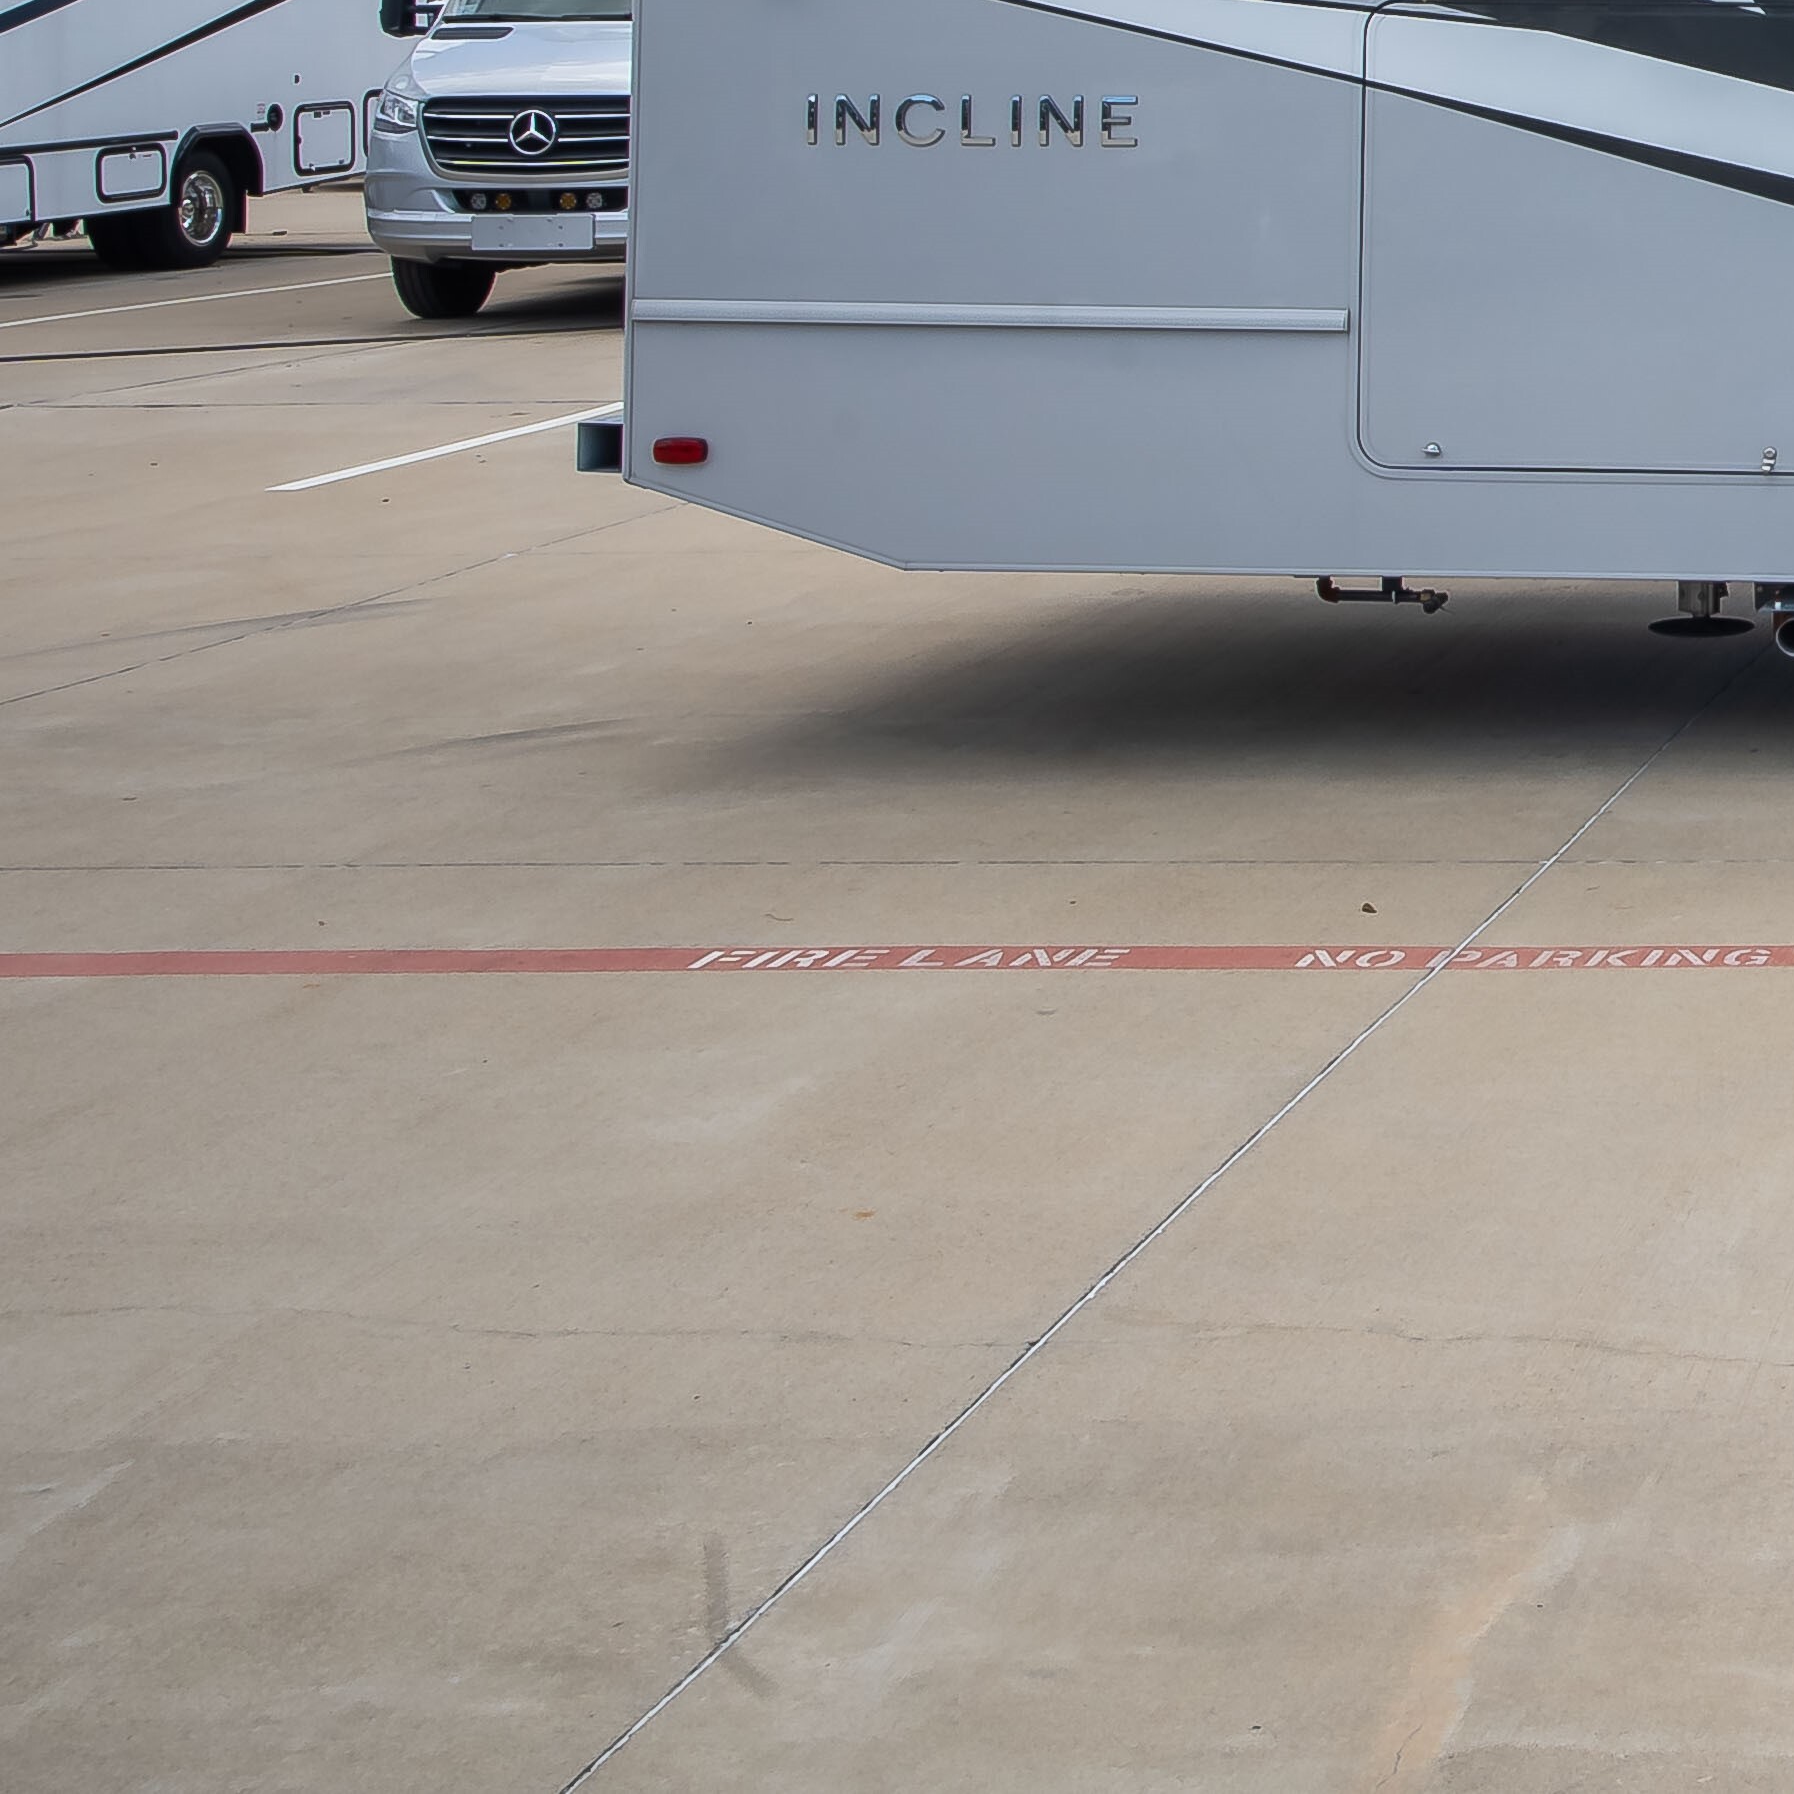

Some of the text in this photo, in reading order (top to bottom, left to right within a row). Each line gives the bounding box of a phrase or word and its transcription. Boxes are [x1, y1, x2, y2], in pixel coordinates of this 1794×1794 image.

[806, 93, 1139, 147] INCLINE
[687, 948, 1131, 969] FIRE LANE
[1294, 947, 1772, 968] NO PARKING
